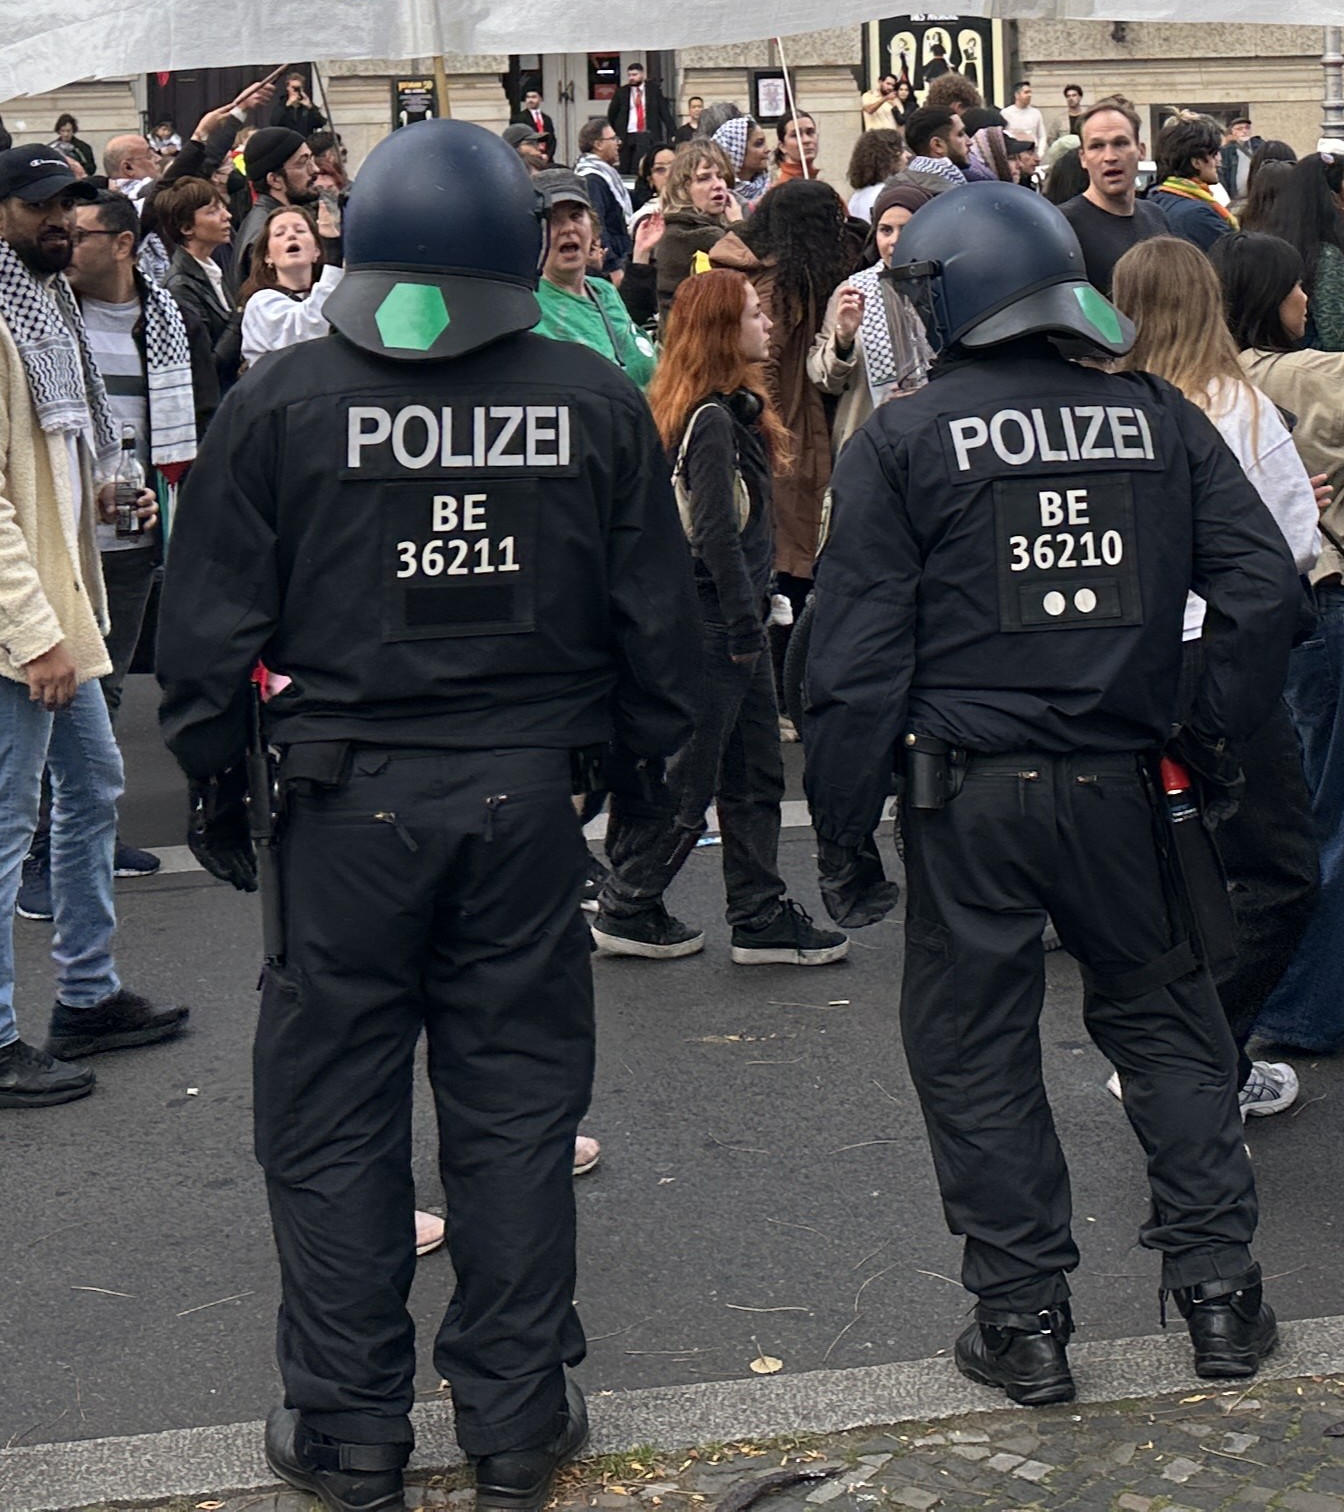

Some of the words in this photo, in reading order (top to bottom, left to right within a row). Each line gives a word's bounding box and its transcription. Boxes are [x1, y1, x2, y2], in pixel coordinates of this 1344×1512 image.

[347, 404, 570, 469] POLIZEI
[949, 405, 1155, 471] POLIZEI
[432, 493, 487, 532] BE
[1038, 489, 1090, 527] BE
[396, 536, 520, 578] 36211
[1009, 530, 1123, 571] 36210
